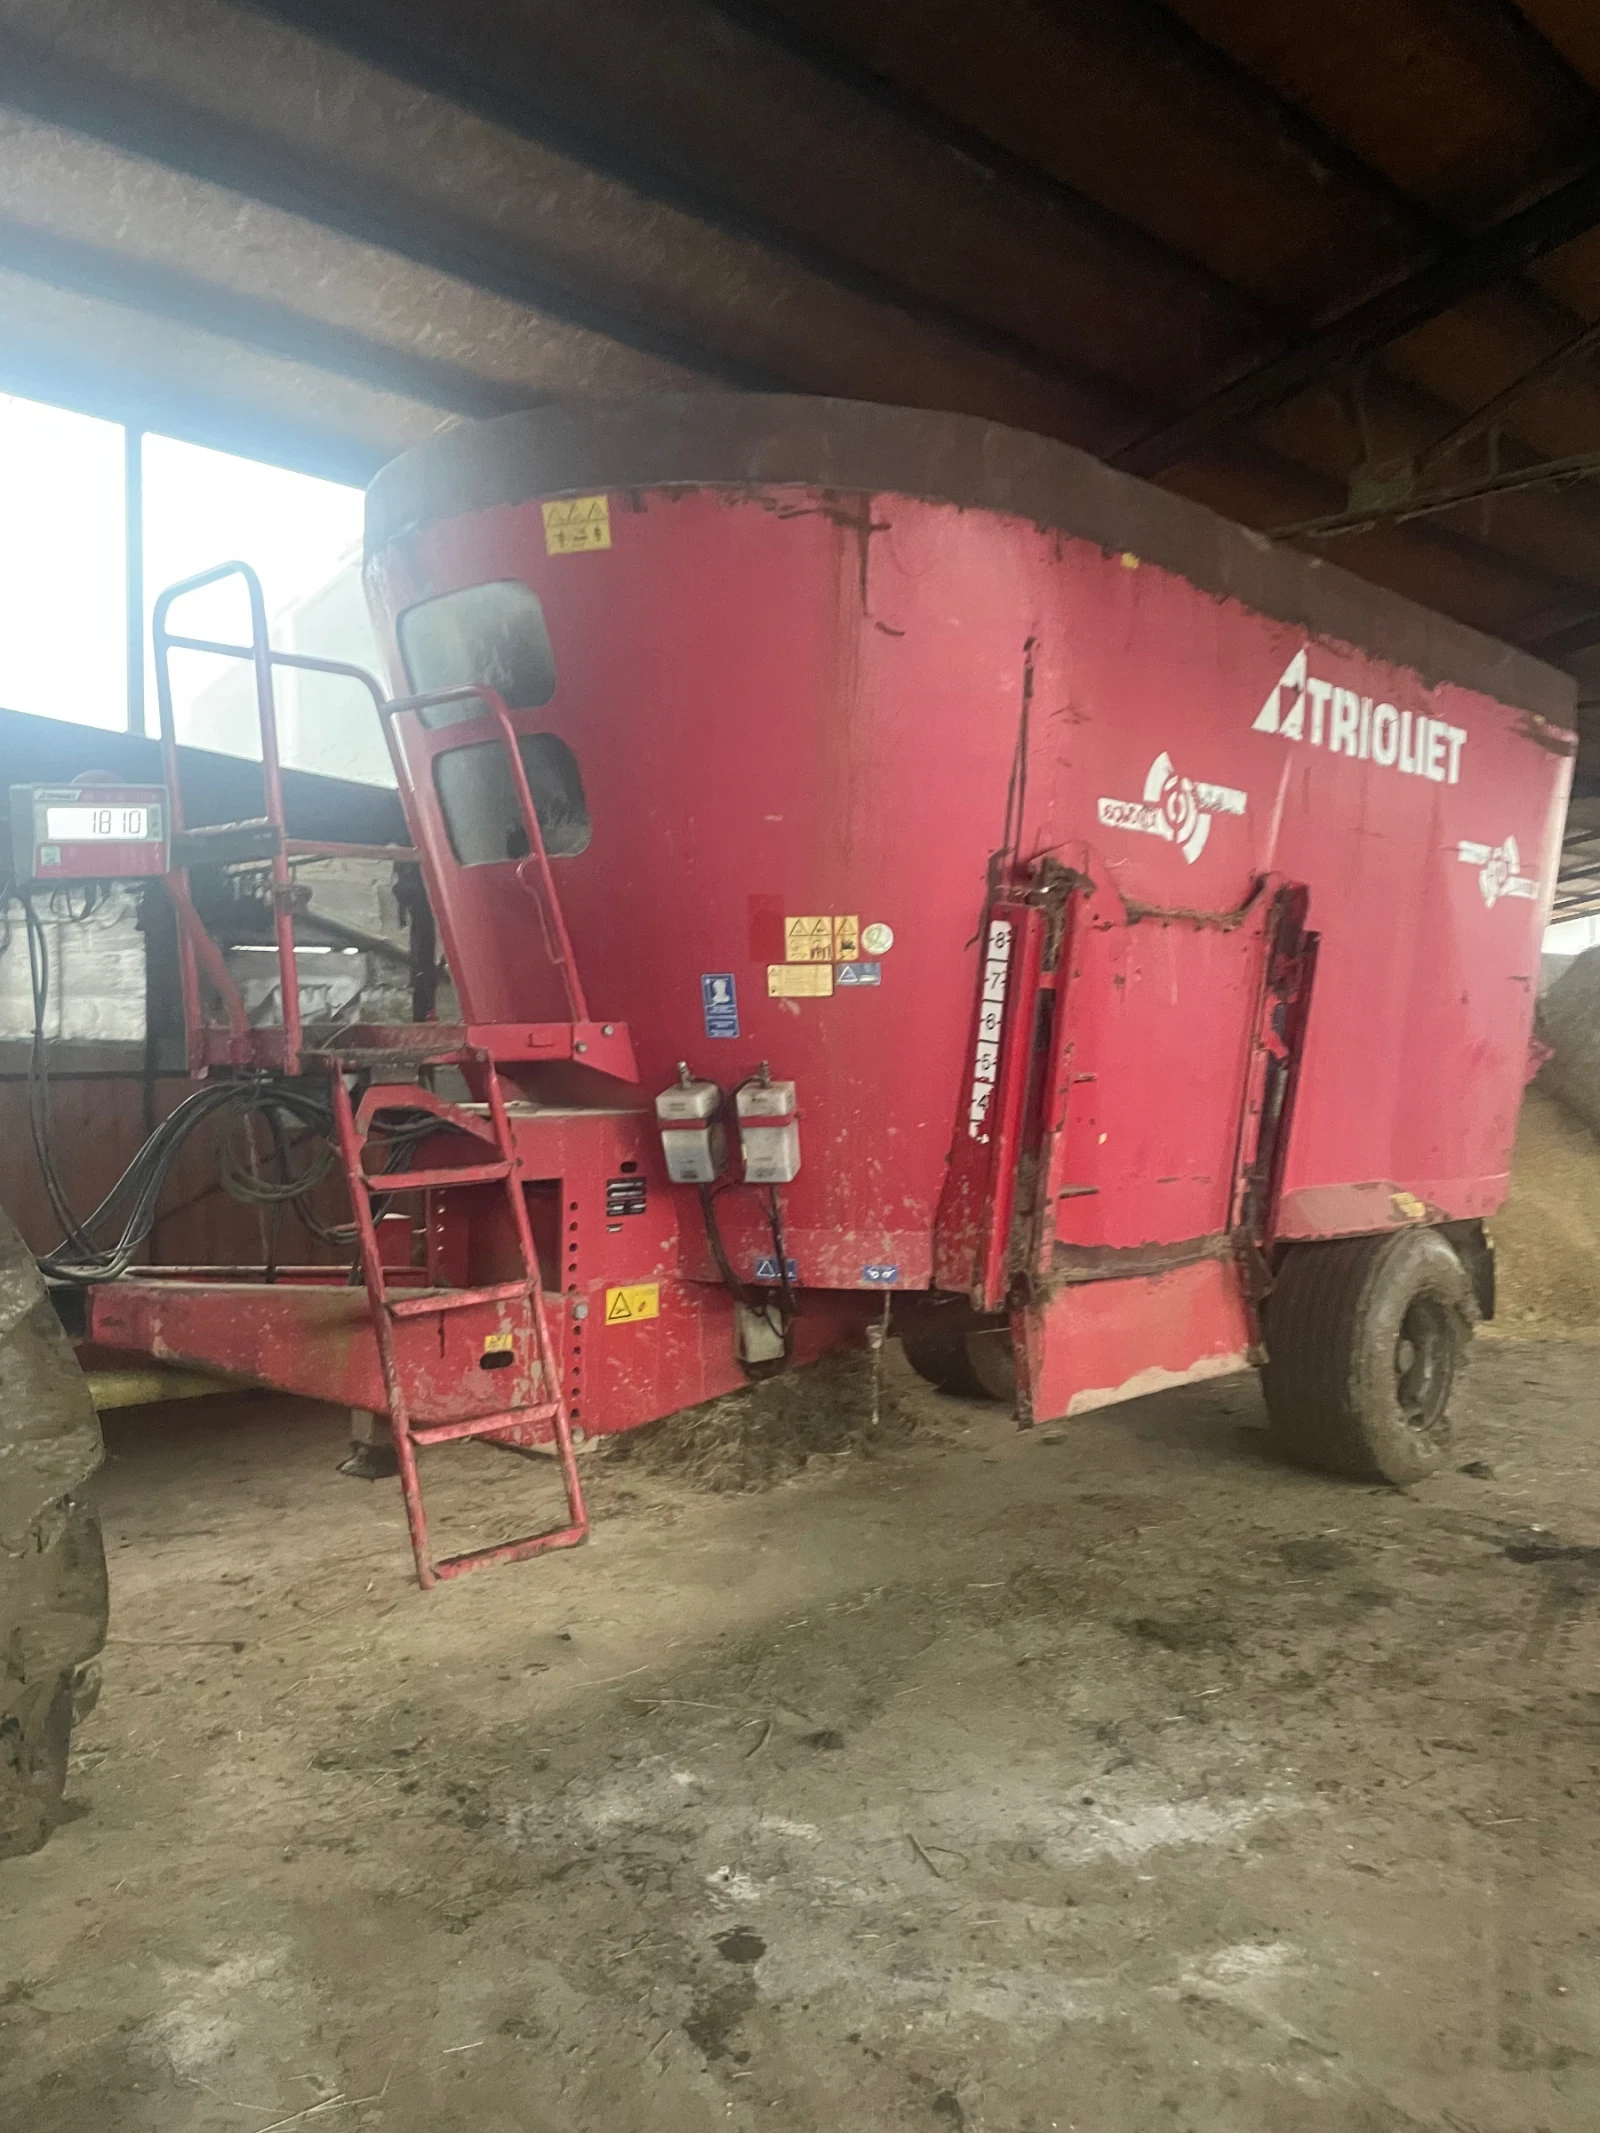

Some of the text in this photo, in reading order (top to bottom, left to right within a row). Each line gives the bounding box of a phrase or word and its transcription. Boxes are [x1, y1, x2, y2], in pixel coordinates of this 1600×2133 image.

[1307, 677, 1468, 784] TRIOLIET
[93, 810, 141, 834] 1810
[995, 931, 1006, 949] 8
[991, 972, 1001, 990] 7
[985, 1012, 996, 1030] 6
